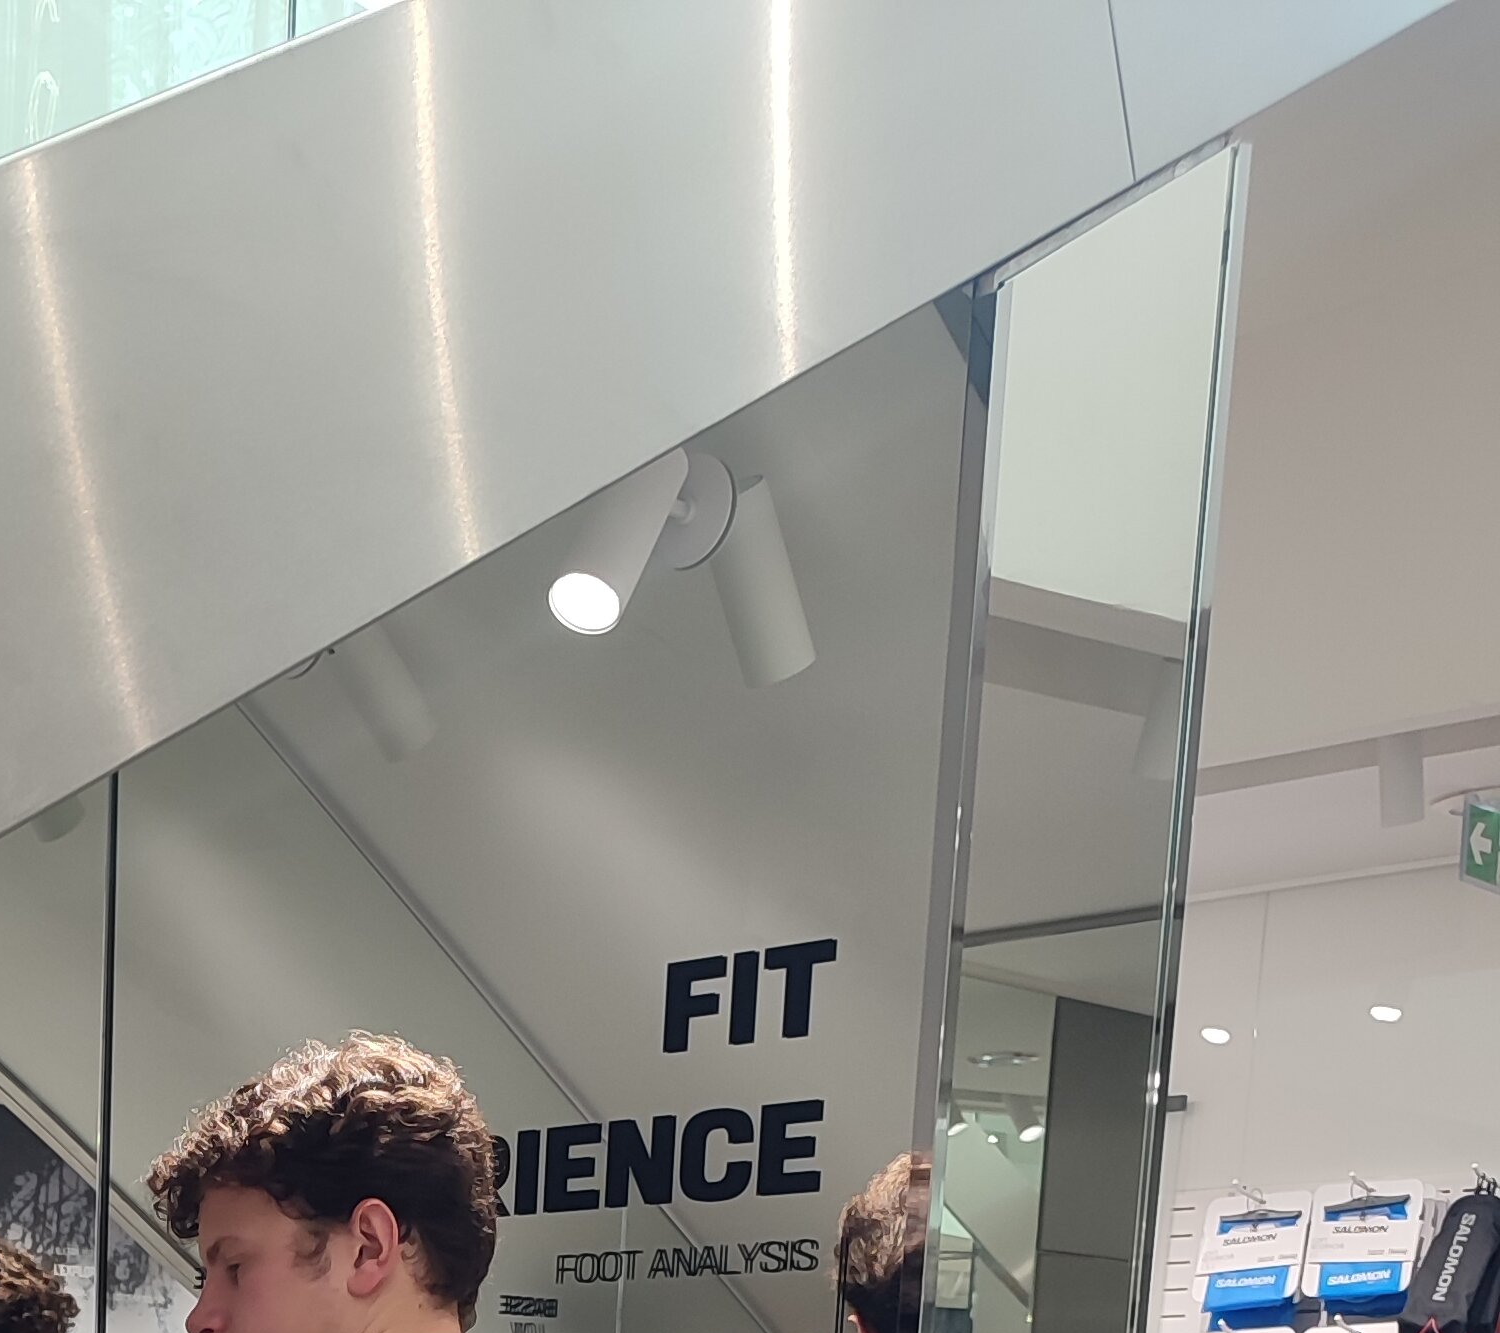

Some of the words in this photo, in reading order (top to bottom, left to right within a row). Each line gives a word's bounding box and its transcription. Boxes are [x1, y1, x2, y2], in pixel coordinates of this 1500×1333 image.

[662, 938, 838, 1053] FIT
[556, 1250, 644, 1284] FOOT
[647, 1238, 819, 1279] ANALYSIS
[1327, 1268, 1393, 1287] SALOMON
[1431, 1212, 1477, 1302] SALOMON
[1214, 1273, 1276, 1289] SALOMON
